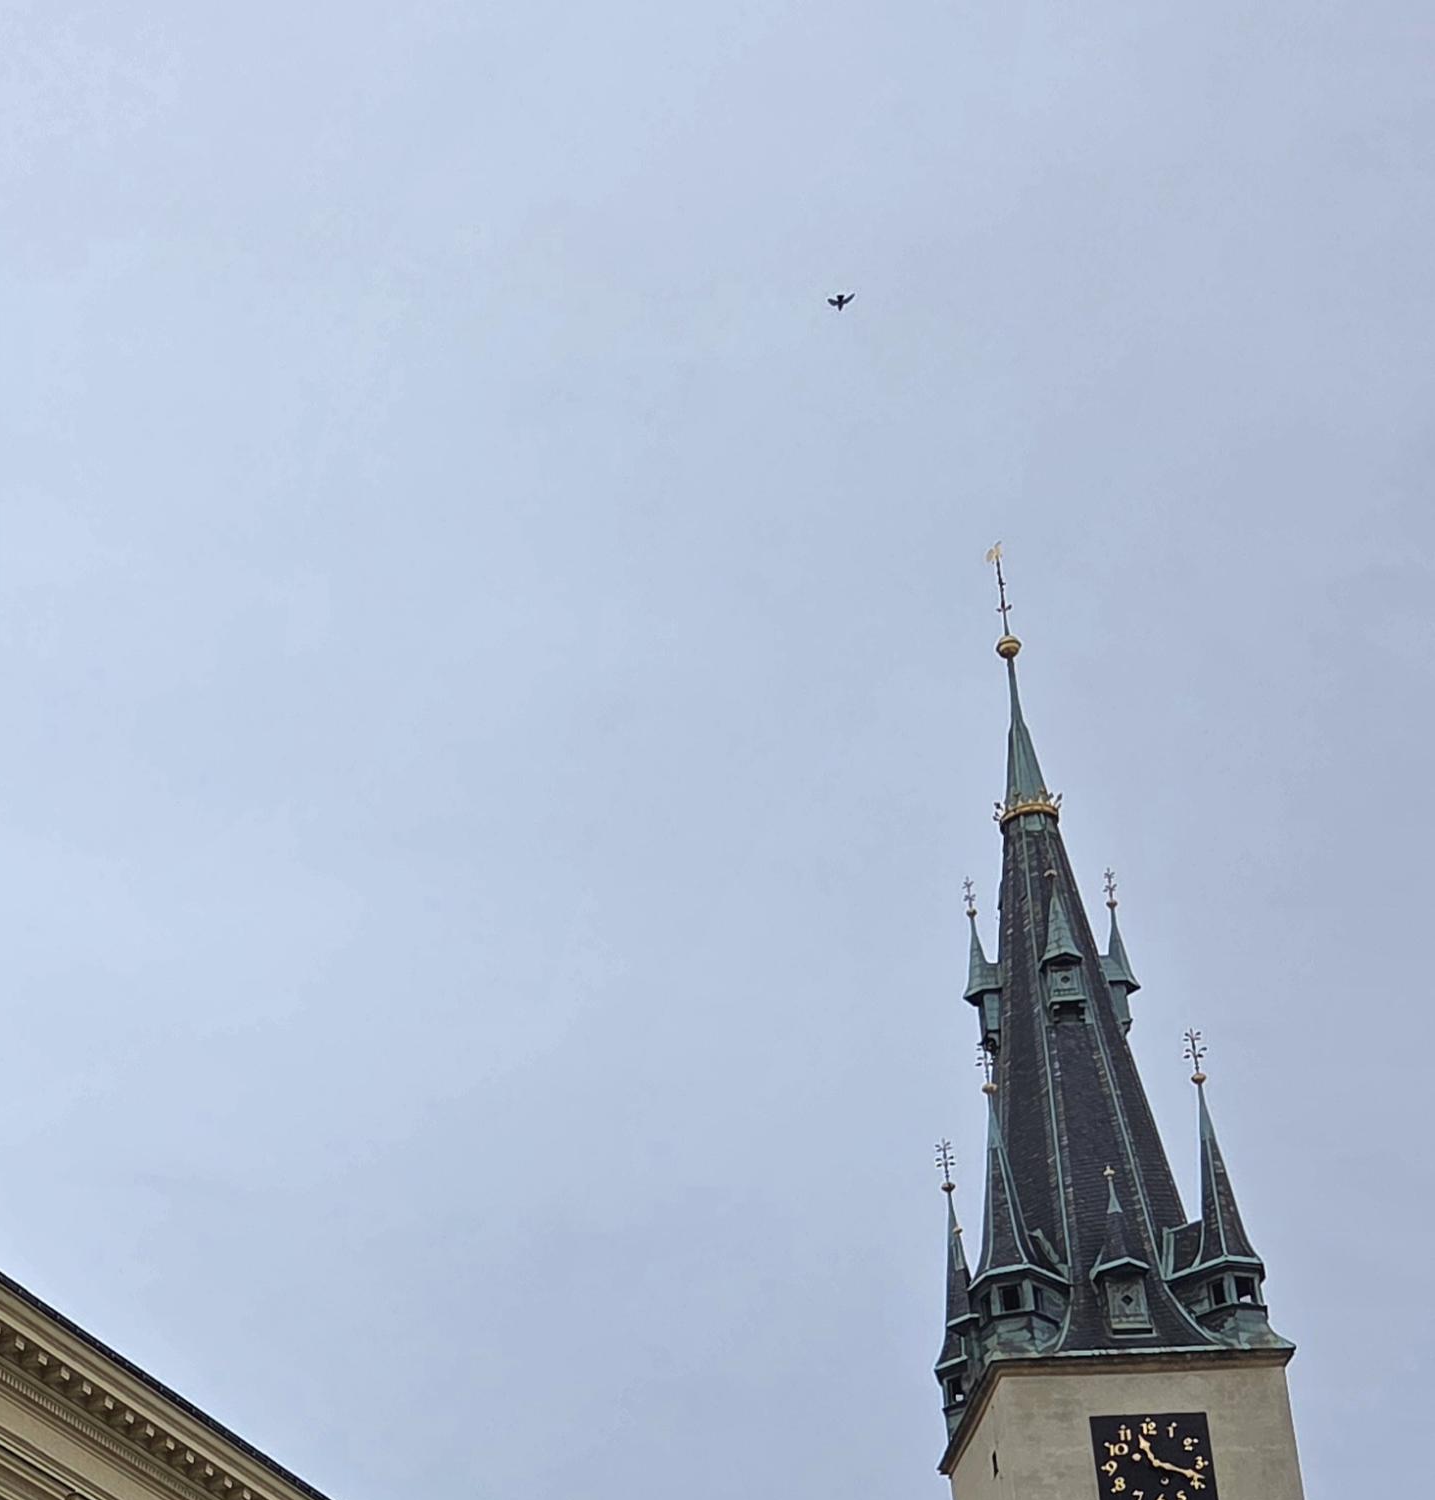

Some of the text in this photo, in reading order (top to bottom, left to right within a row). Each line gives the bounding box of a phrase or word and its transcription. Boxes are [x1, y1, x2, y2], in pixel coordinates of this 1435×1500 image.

[1118, 1428, 1132, 1441] 11
[1139, 1422, 1157, 1435] 12
[1109, 1443, 1129, 1456] 10
[1105, 1460, 1118, 1477] 9
